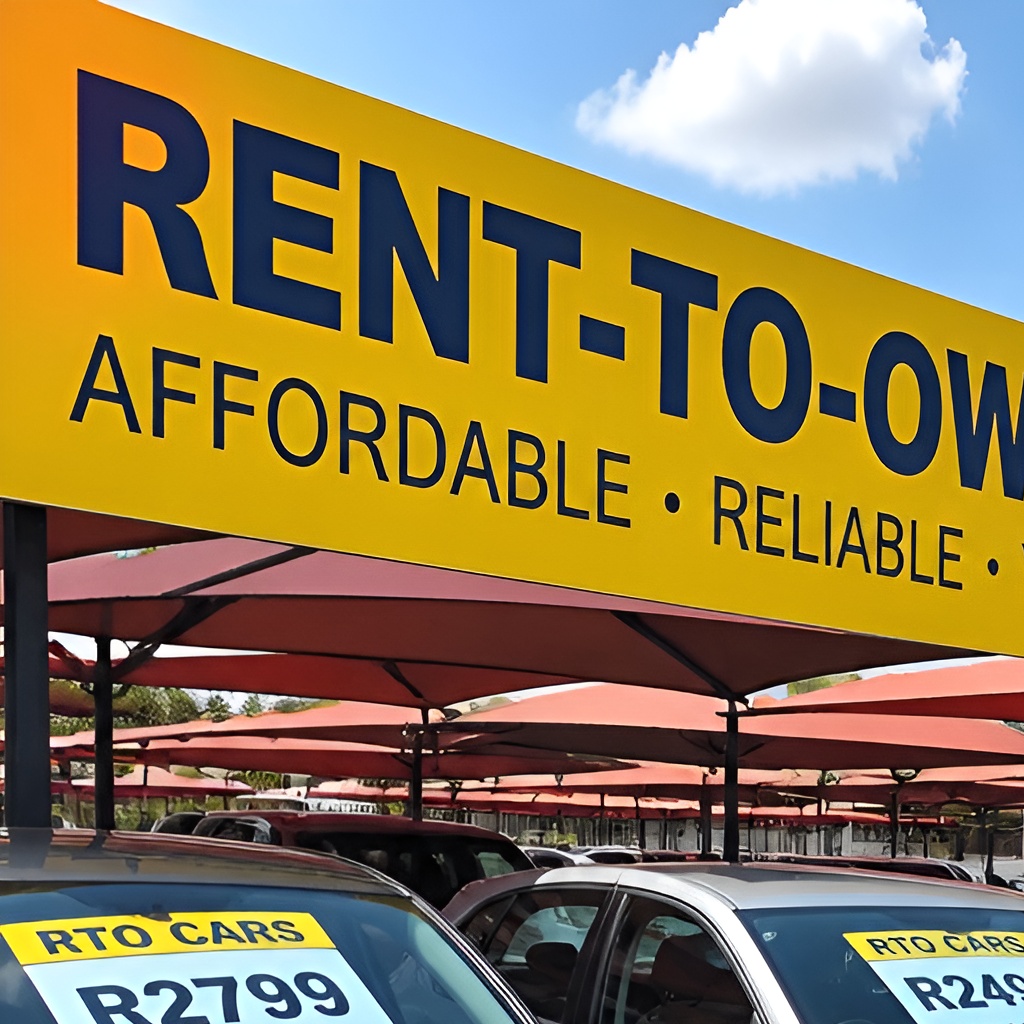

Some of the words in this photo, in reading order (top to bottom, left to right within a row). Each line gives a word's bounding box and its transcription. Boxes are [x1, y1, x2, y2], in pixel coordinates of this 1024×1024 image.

[69, 333, 631, 527] AFFORDABLE
[713, 475, 963, 590] RELIABLE
[35, 926, 153, 955] RTO
[169, 918, 306, 946] CARS
[866, 936, 937, 956] RTO
